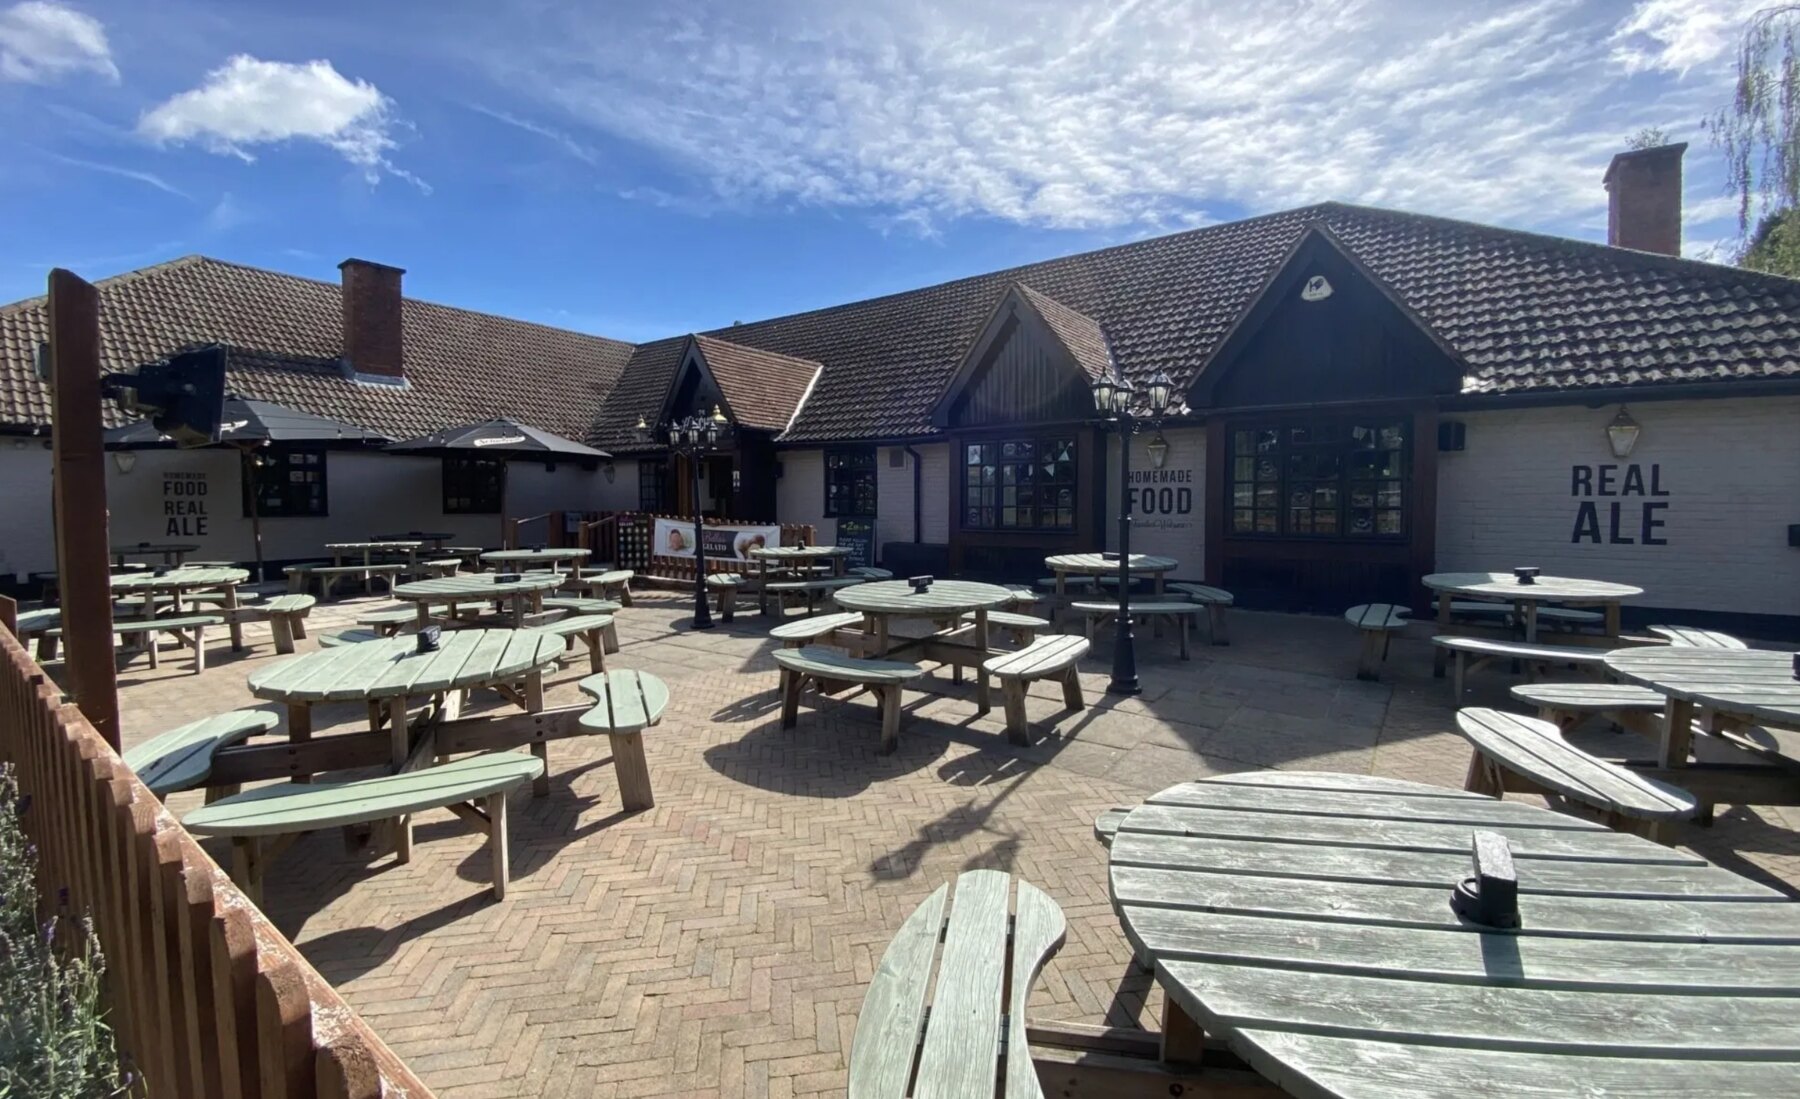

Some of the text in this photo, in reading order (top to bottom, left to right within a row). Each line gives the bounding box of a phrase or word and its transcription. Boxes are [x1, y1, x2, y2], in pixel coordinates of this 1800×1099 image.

[1128, 469, 1192, 483] HOMEMADE
[1571, 464, 1670, 496] REAL
[163, 481, 208, 496] FOOD
[164, 501, 208, 515] REAL
[1127, 487, 1192, 514] FOOD
[166, 517, 208, 536] ALE
[1571, 501, 1669, 545] ALE
